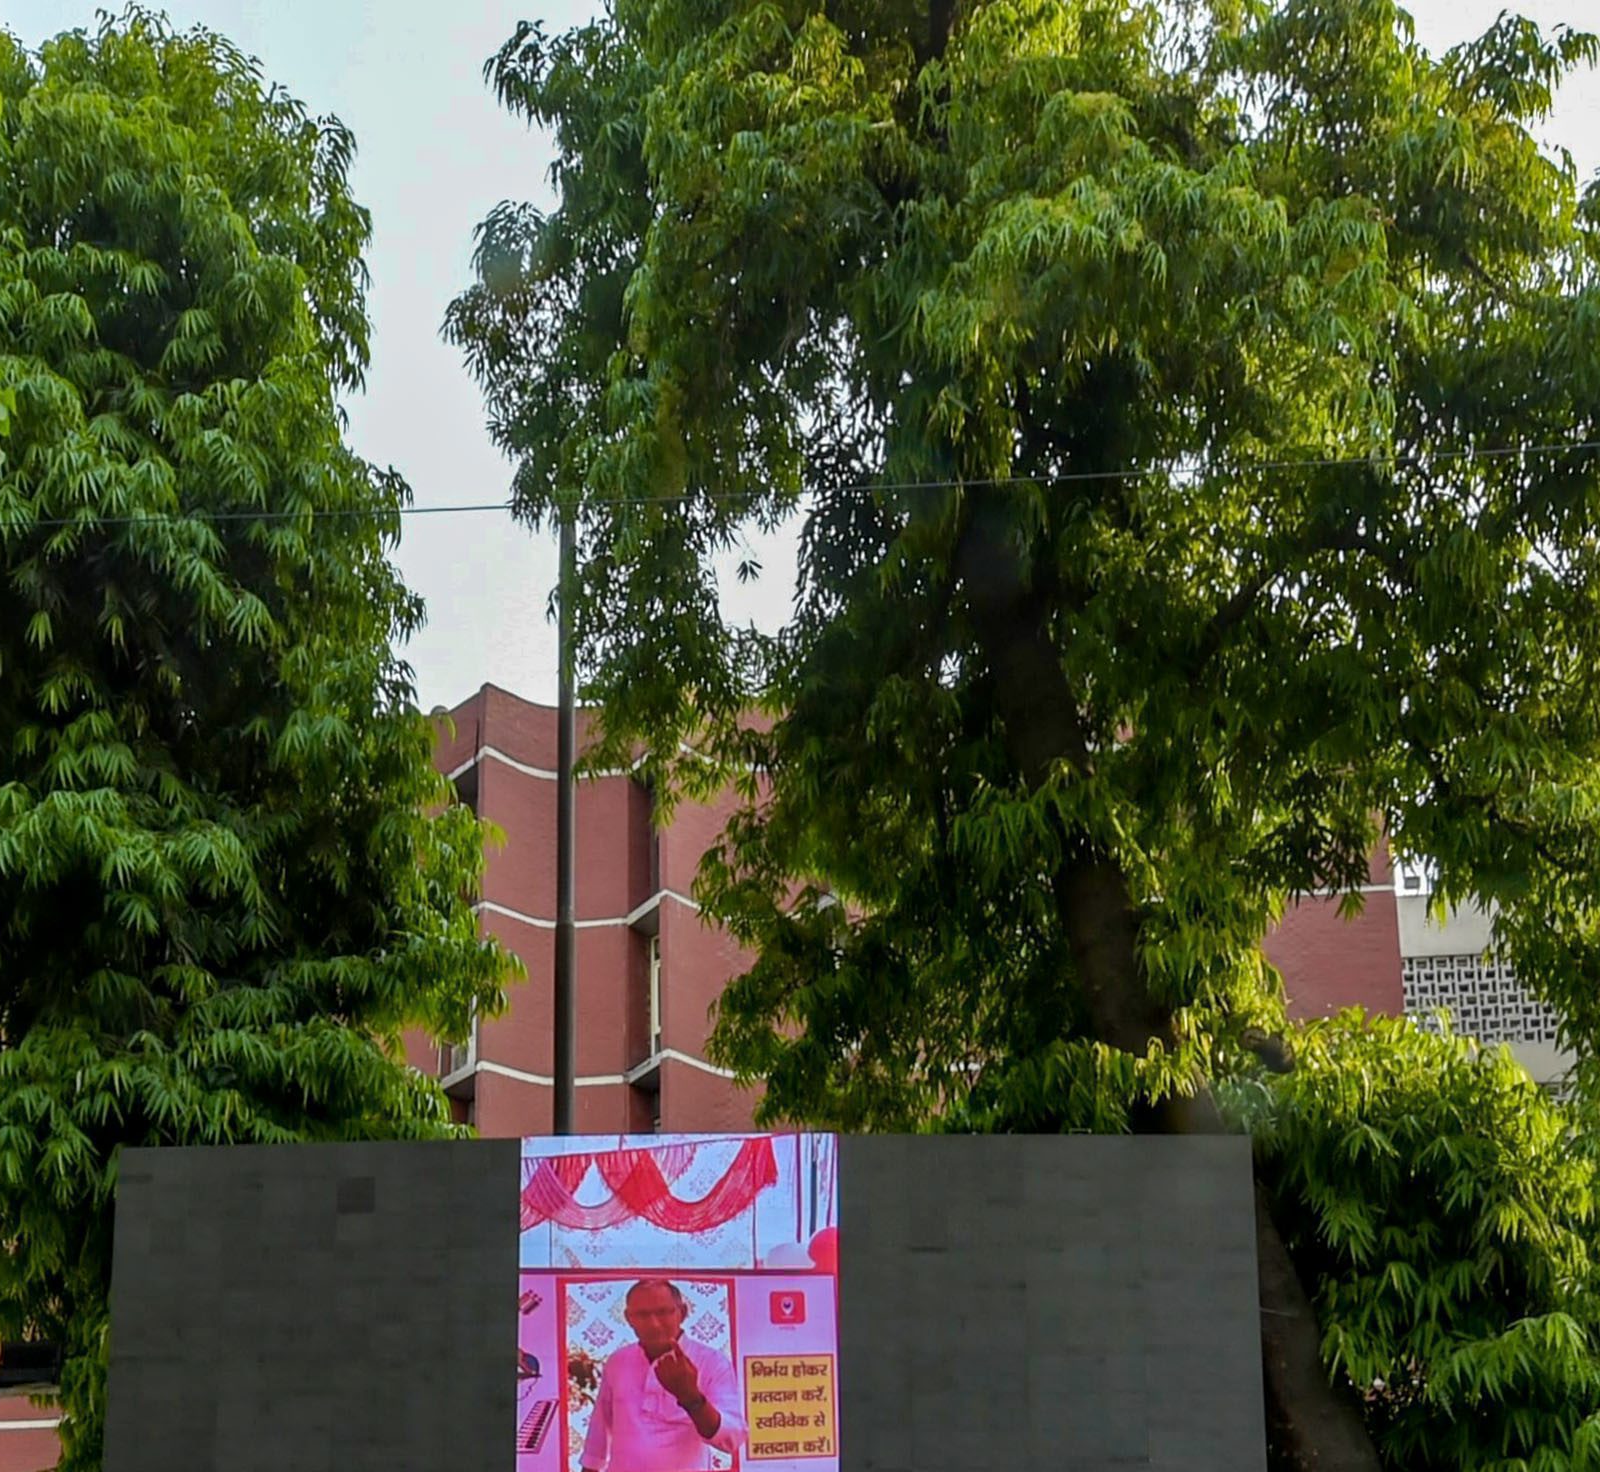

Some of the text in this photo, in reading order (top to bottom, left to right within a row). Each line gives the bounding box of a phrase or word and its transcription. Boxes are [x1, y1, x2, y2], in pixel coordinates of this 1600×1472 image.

[751, 1361, 828, 1378] निर्भय होकर
[751, 1390, 797, 1403] मतदान
[813, 1411, 826, 1427] से
[752, 1441, 799, 1455] मतदान
